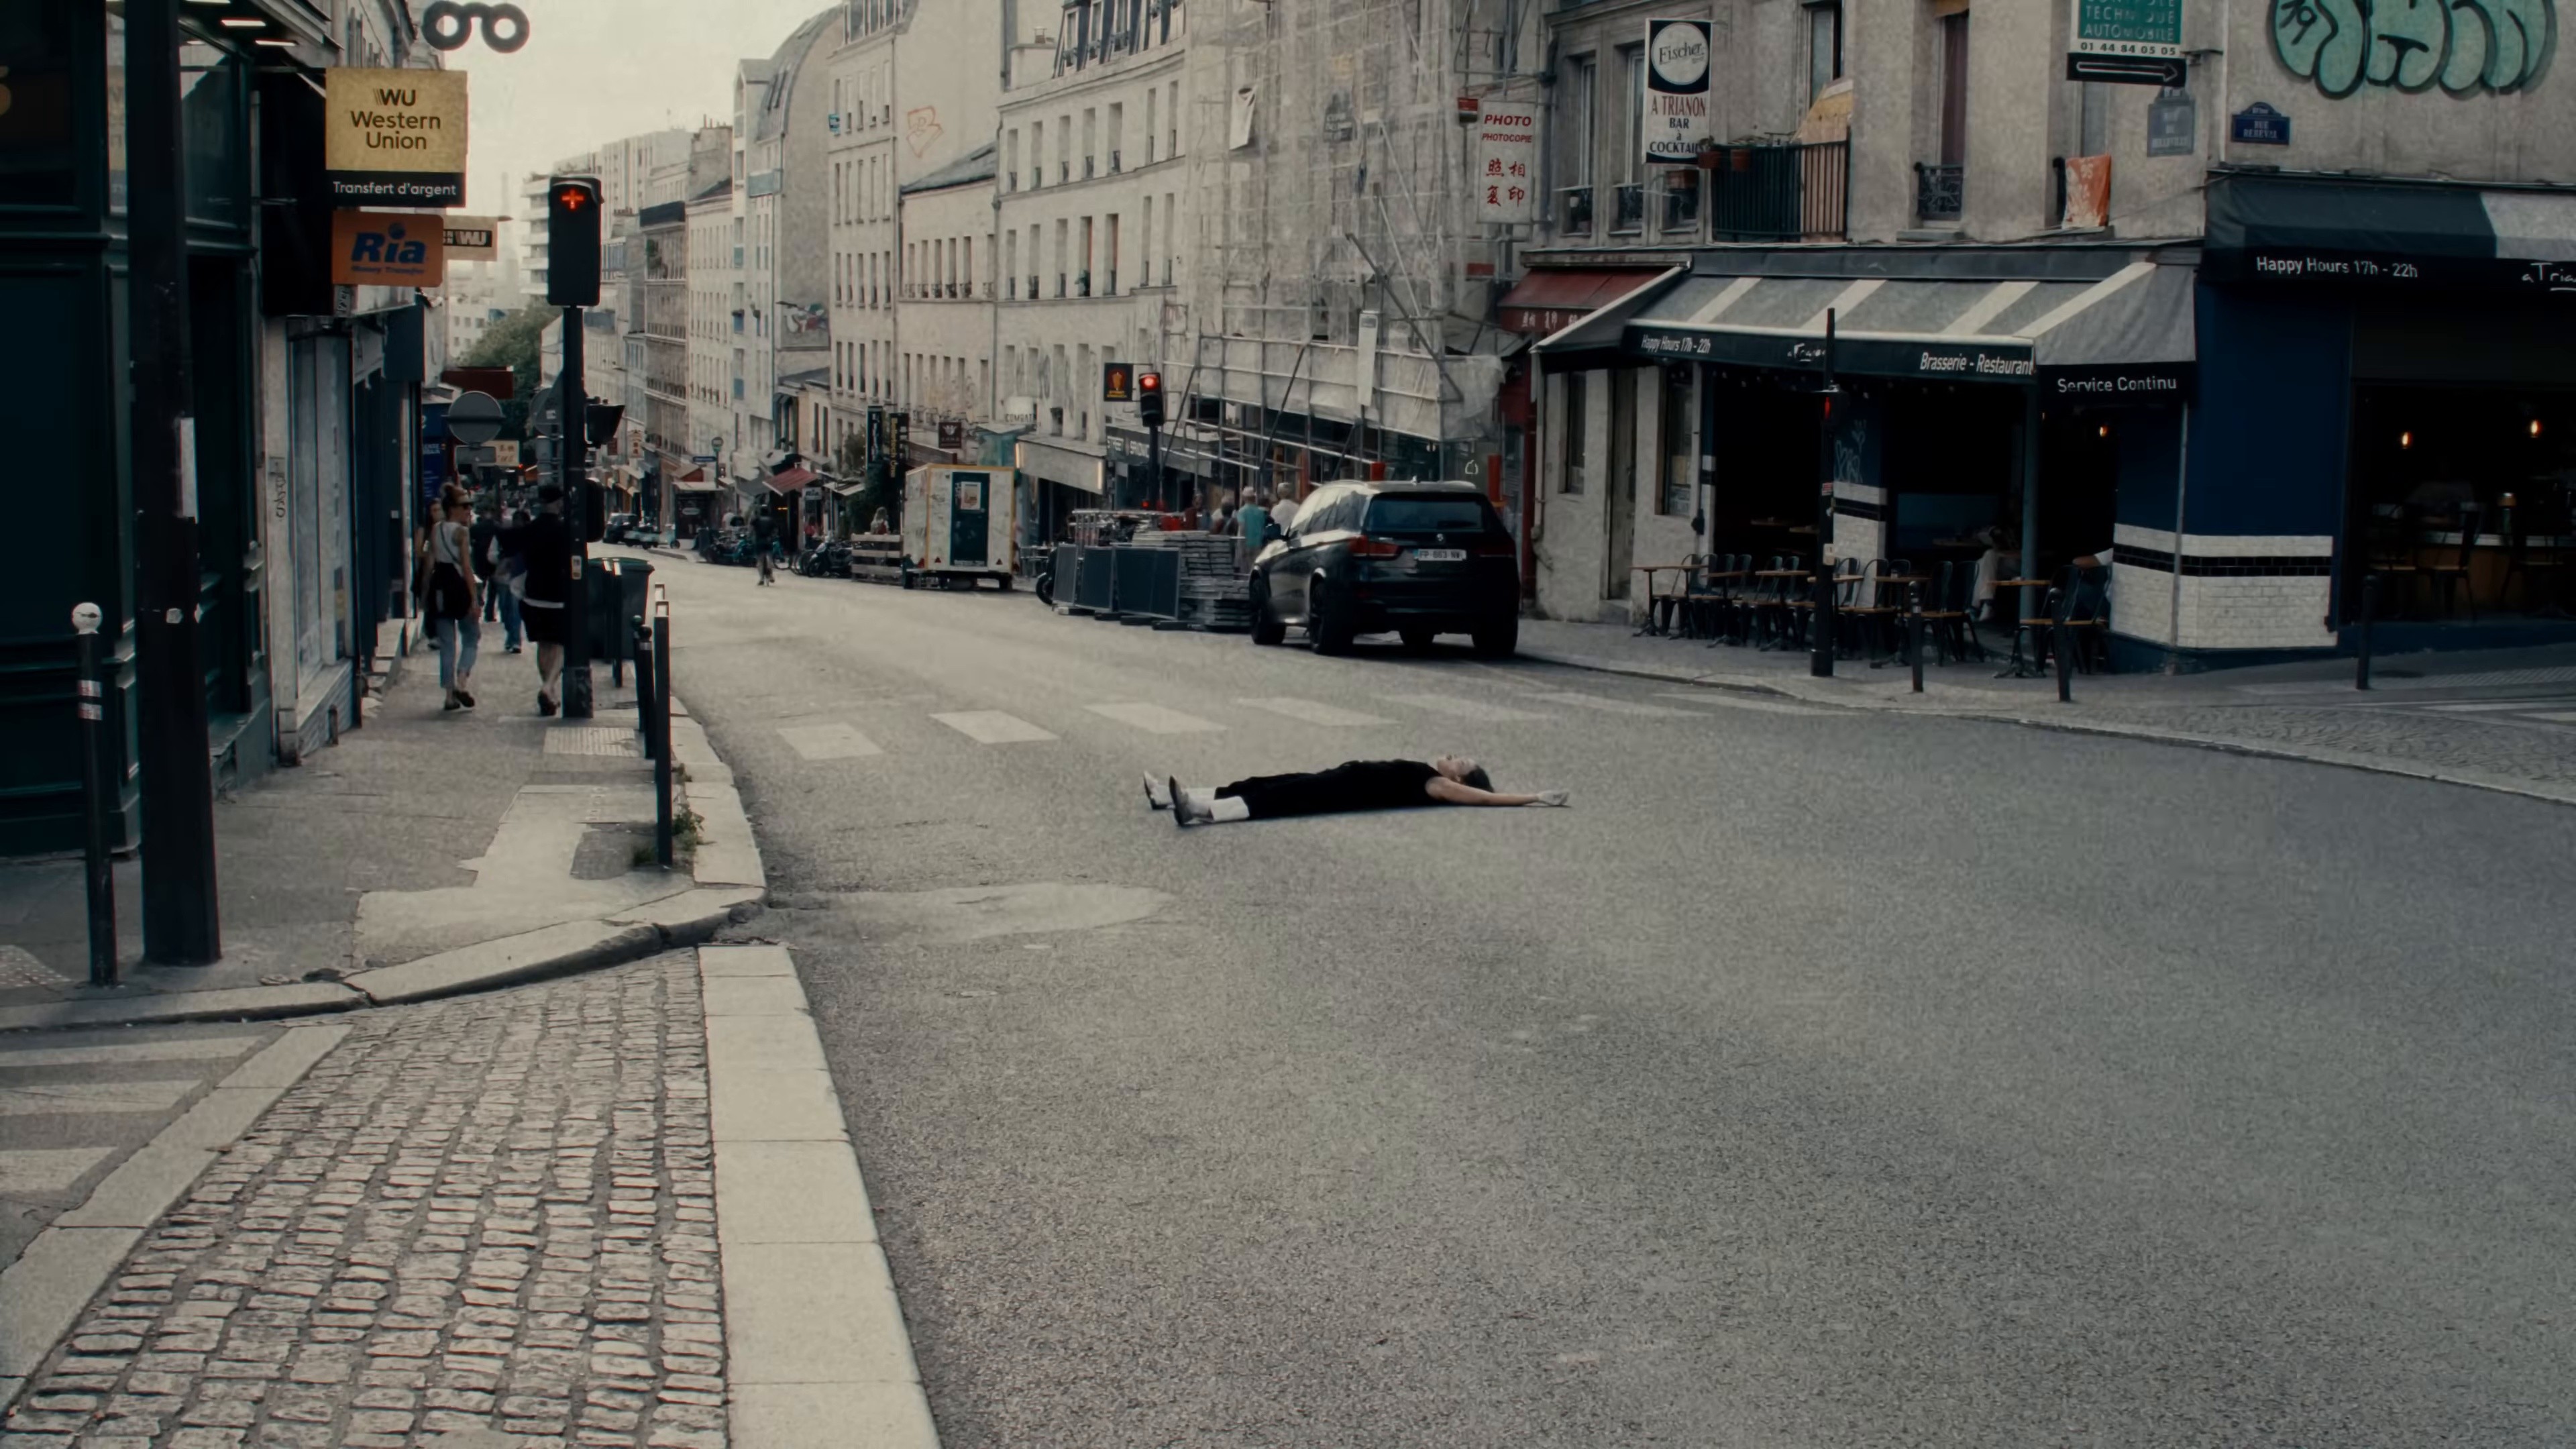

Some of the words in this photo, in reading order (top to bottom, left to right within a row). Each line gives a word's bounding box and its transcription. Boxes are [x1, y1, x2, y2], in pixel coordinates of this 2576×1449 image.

[2084, 23, 2174, 41] AUTOMOBILE
[1659, 42, 1703, 64] Fischer
[2080, 42, 2094, 51] 01
[2100, 43, 2115, 52] 44
[2121, 44, 2136, 53] 84
[2141, 46, 2155, 54] 05
[2161, 47, 2176, 55] 05
[374, 89, 416, 107] WU
[1651, 95, 1658, 115] A
[1662, 95, 1706, 117] TRIANON
[350, 111, 441, 129] Western
[1484, 114, 1532, 127] PHOTO
[1669, 117, 1689, 129] BAR
[366, 131, 427, 149] Union
[1482, 133, 1532, 143] PHOTOCOPIE
[1486, 158, 1525, 177] 照相
[333, 181, 394, 194] Transfert
[398, 182, 456, 197] d'argent
[1487, 184, 1525, 207] 复印
[351, 223, 427, 264] Ria
[458, 231, 486, 246] WU
[2257, 256, 2303, 274] Happy
[2306, 258, 2349, 273] Hours
[2353, 260, 2378, 275] 17h
[2392, 262, 2418, 278] 22h
[1641, 334, 1662, 353] Happy
[1660, 335, 1680, 352] Hours
[1680, 337, 1693, 353] 17h
[1920, 352, 1967, 371] Brasserie
[1976, 354, 2033, 376] Restaurant
[2057, 378, 2113, 393] Service
[2117, 376, 2177, 391] Continu
